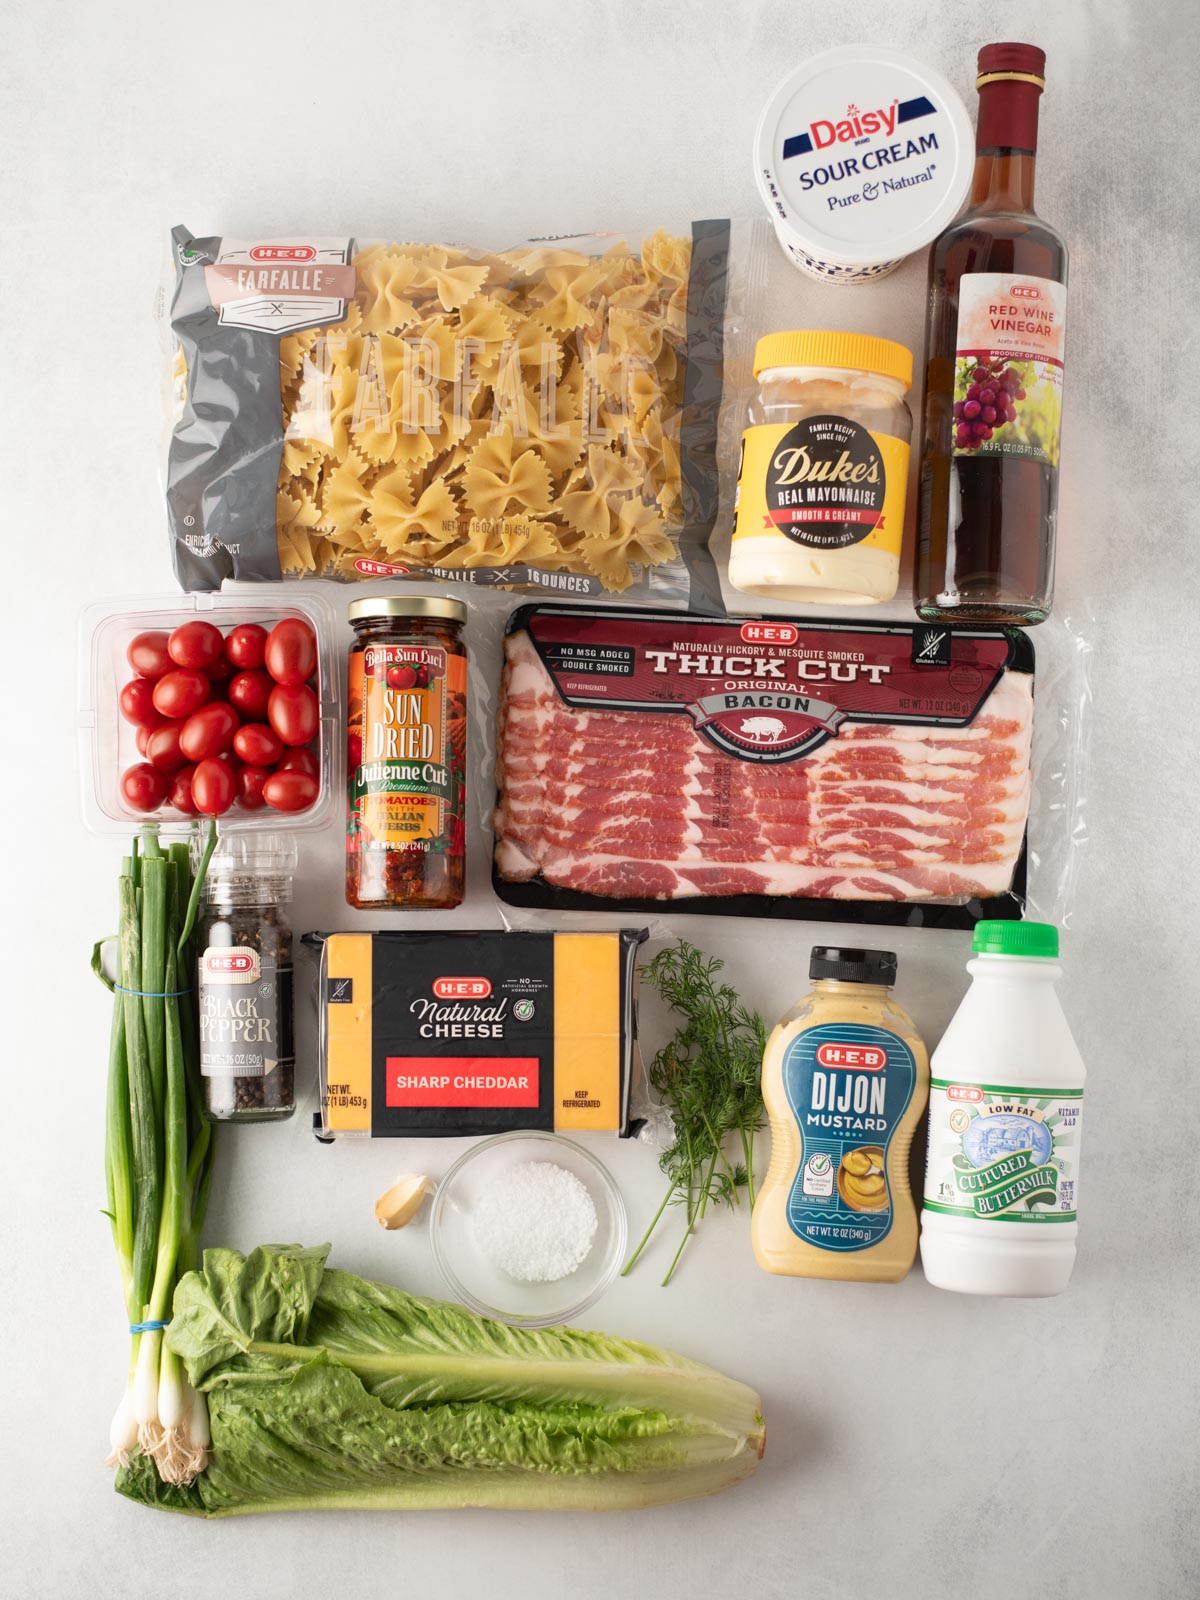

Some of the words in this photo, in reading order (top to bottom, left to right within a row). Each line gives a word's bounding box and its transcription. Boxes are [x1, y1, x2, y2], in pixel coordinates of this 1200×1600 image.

[810, 104, 896, 150] Daisy
[854, 137, 870, 146] BRAND
[799, 158, 861, 190] SOUR
[862, 133, 940, 171] CREAM
[827, 194, 861, 211] Pure
[862, 182, 881, 201] &
[237, 269, 324, 292] FARFALLE
[989, 305, 1018, 316] RED
[1023, 307, 1055, 323] WINE
[990, 319, 1051, 337] VINEGAR
[990, 350, 1023, 358] PRODUCT
[1034, 354, 1050, 362] ITALY
[809, 423, 833, 434] FAMILY
[834, 424, 857, 438] RECIPE
[816, 433, 834, 441] SINCE
[994, 443, 1002, 452] FL
[1002, 443, 1011, 452] OZ
[773, 445, 880, 485] Duke's
[777, 491, 804, 507] REAL
[806, 487, 876, 506] MAYONNAISE
[791, 511, 822, 521] SMOOTH
[825, 511, 830, 520] &
[832, 510, 862, 521] CREAMY
[442, 520, 455, 531] NET
[472, 521, 479, 533] 16
[481, 522, 491, 533] OZ
[513, 524, 530, 539] 454g
[527, 568, 540, 583] 16
[541, 573, 591, 593] OUNCES
[365, 649, 393, 669] Bella
[395, 648, 418, 662] Sun
[419, 649, 443, 669] Luci
[560, 648, 573, 656] NO
[576, 648, 597, 657] MSG
[600, 649, 630, 659] ADDED
[673, 642, 722, 653] NATURALLY
[726, 645, 766, 656] HICKORY
[768, 647, 775, 656] &
[778, 649, 824, 660] MESQUITE
[827, 651, 865, 662] SMOKED
[562, 661, 594, 671] DOUBLE
[596, 663, 630, 673] SMOKED
[645, 650, 785, 678] THICK
[798, 660, 891, 684] CUT
[577, 684, 608, 692] REFRIGERATED
[724, 681, 809, 694] ORIGINAL
[383, 690, 422, 725] SUN
[724, 694, 810, 712] BACON
[899, 698, 910, 708] NET
[925, 700, 933, 710] 12
[935, 700, 944, 711] OZ
[372, 723, 435, 759] DRIED
[357, 761, 421, 788] Julienne
[421, 763, 448, 787] Cut
[380, 780, 429, 792] Premium
[203, 995, 259, 1018] BLACK
[410, 997, 508, 1022] Natural
[200, 1014, 273, 1042] PEPPER
[419, 1024, 504, 1038] CHEESE
[234, 1054, 245, 1064] OZ
[327, 1084, 339, 1095] NET
[397, 1076, 450, 1089] SHARP
[453, 1076, 529, 1089] CHEDDAR
[339, 1096, 349, 1109] LB)
[349, 1096, 362, 1107] 453
[575, 1090, 588, 1098] KEEP
[811, 1071, 887, 1116] DIJON
[562, 1099, 600, 1108] REFRIGERATED
[989, 1105, 1014, 1114] LOW
[1016, 1106, 1036, 1118] FAT
[806, 1113, 888, 1131] MUSTARD
[978, 1171, 1055, 1213] BUTTERMILK
[806, 1225, 819, 1235] NET
[832, 1227, 839, 1237] 12
[840, 1228, 848, 1238] OZ
[849, 1228, 863, 1239] (340
[864, 1229, 872, 1241] g)
